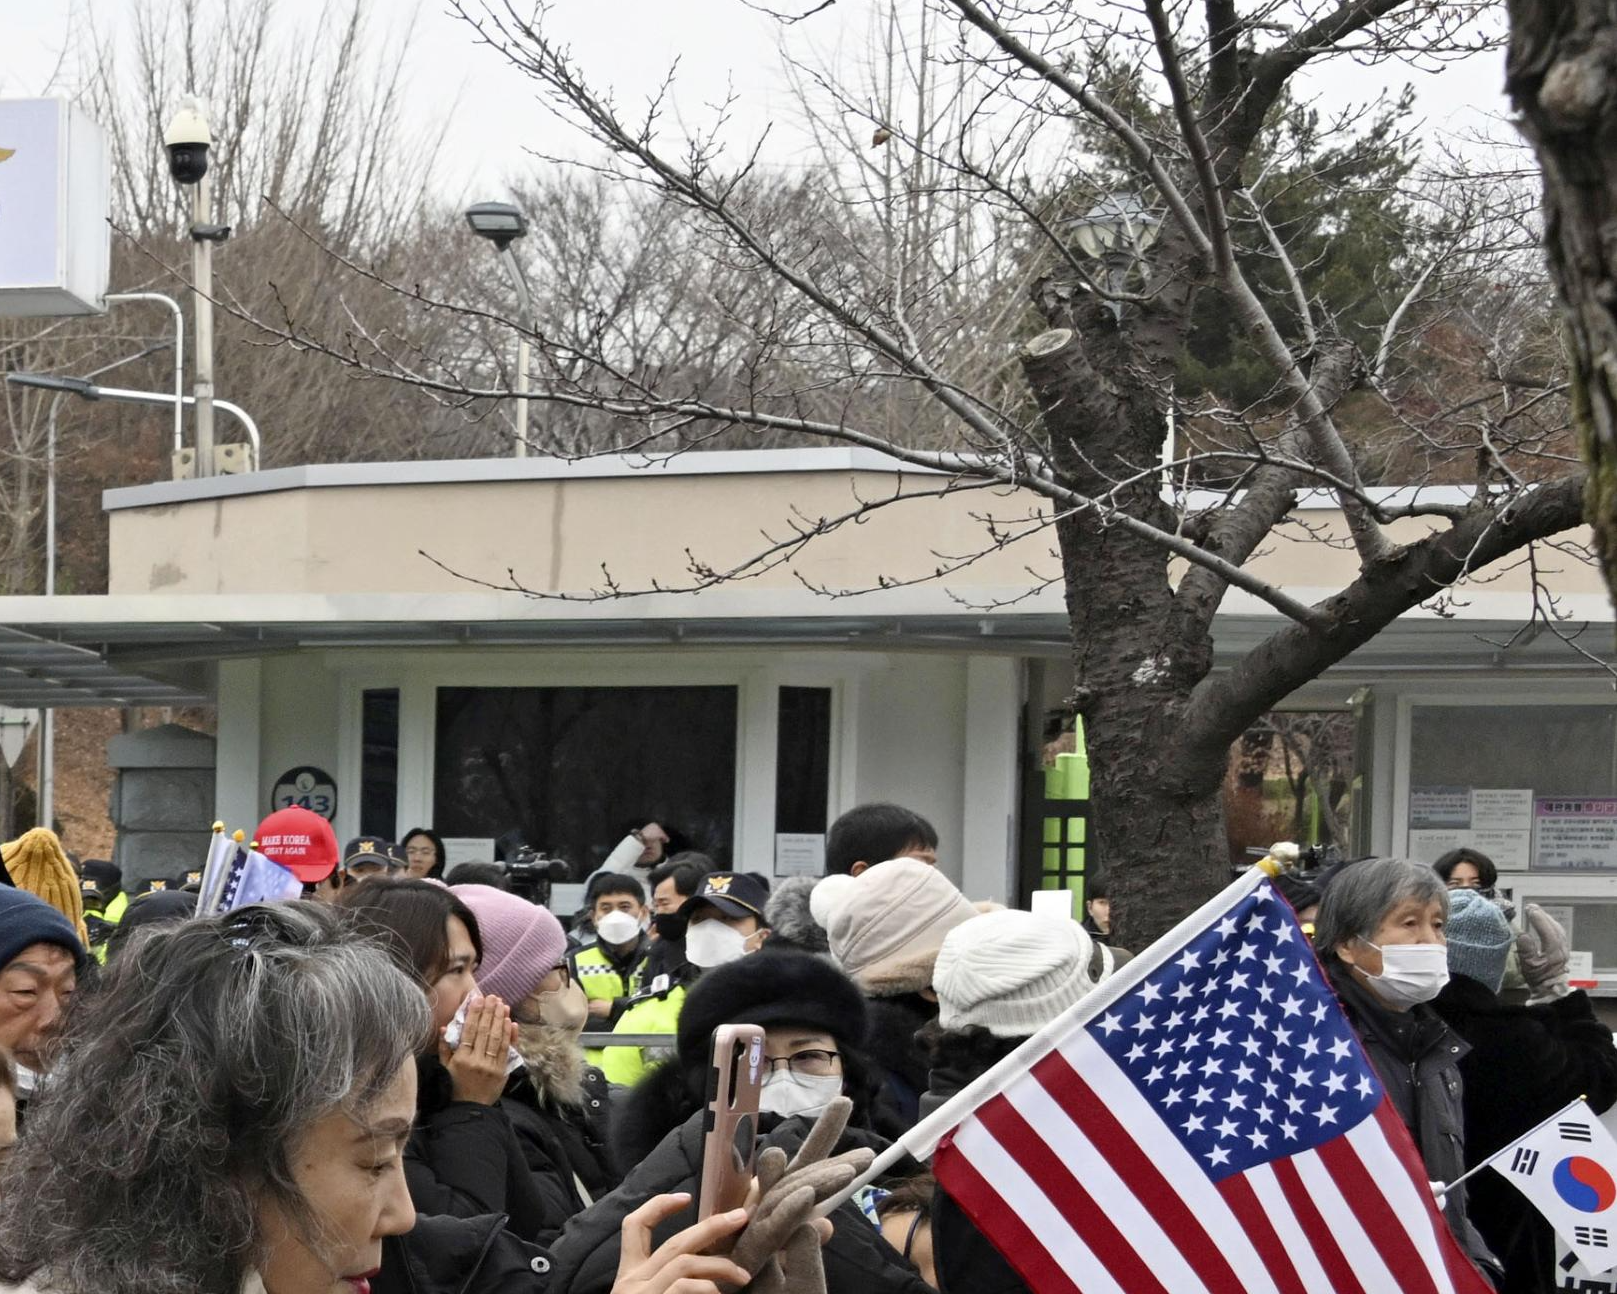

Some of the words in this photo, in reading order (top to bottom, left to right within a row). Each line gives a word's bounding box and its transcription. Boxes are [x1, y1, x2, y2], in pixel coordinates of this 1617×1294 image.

[281, 795, 331, 813] 143
[261, 835, 282, 846] MAKE
[283, 835, 311, 846] KOREA
[264, 847, 284, 855] GREAT
[284, 847, 306, 855] AGAIN
